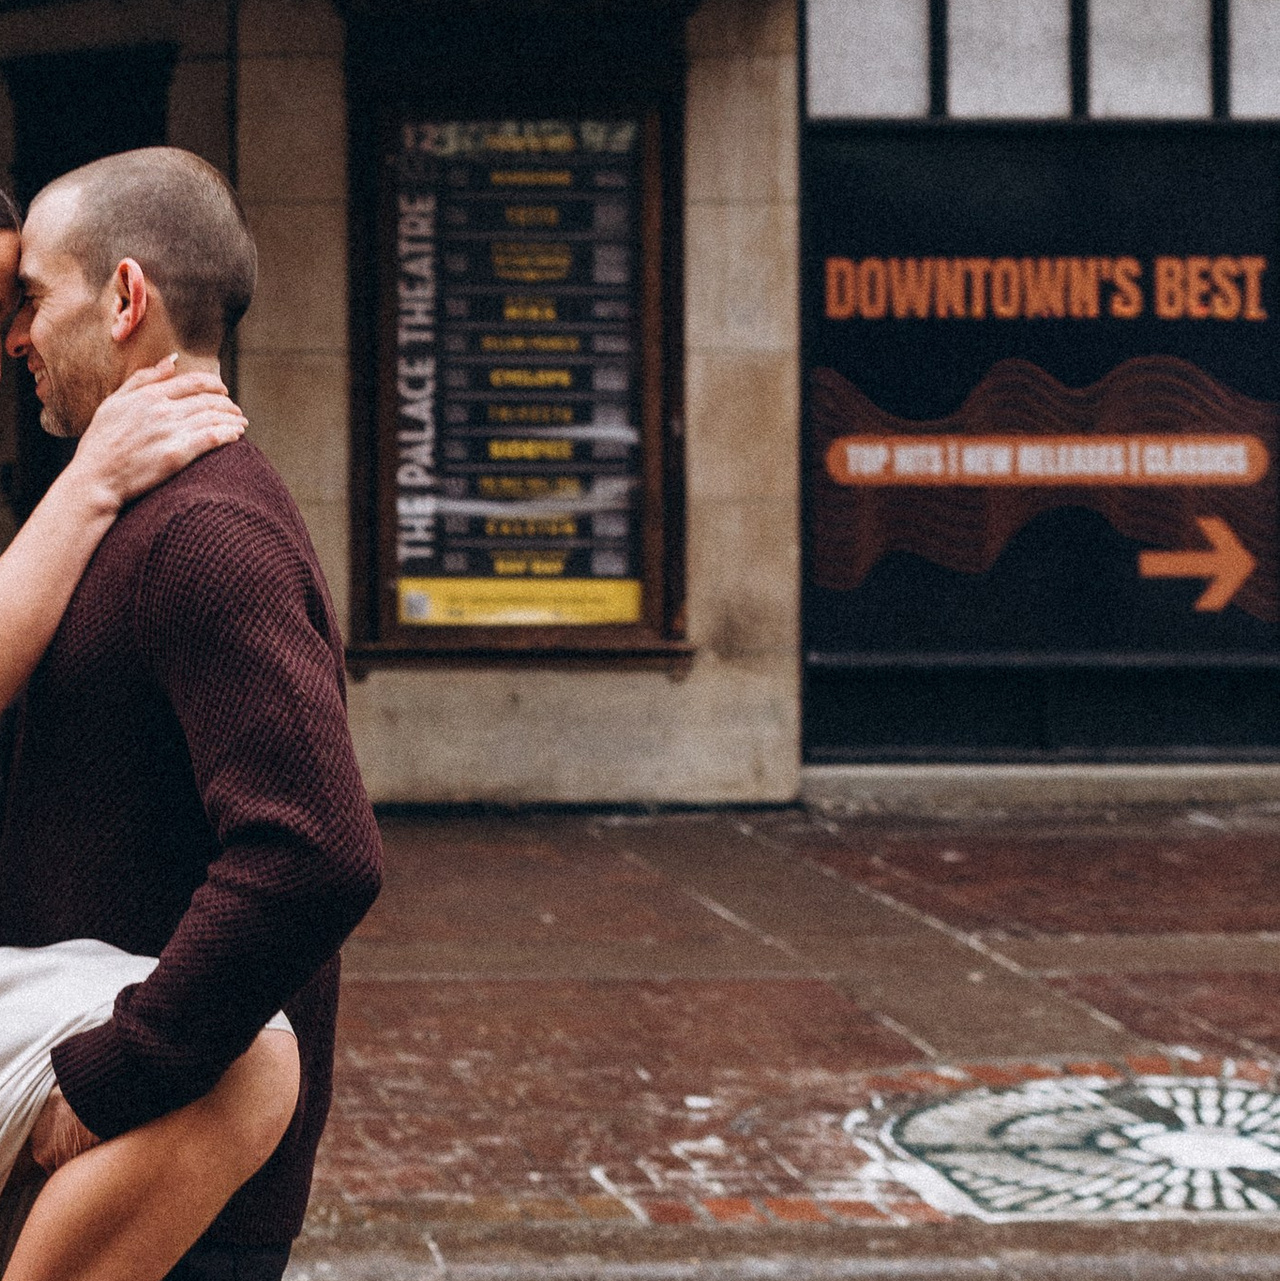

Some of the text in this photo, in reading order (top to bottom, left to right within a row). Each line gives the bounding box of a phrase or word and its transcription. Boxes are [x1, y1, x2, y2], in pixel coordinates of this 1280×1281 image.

[397, 194, 436, 561] THE PALACE THEATRE
[825, 255, 1268, 320] DOWNTOWN'S BEST
